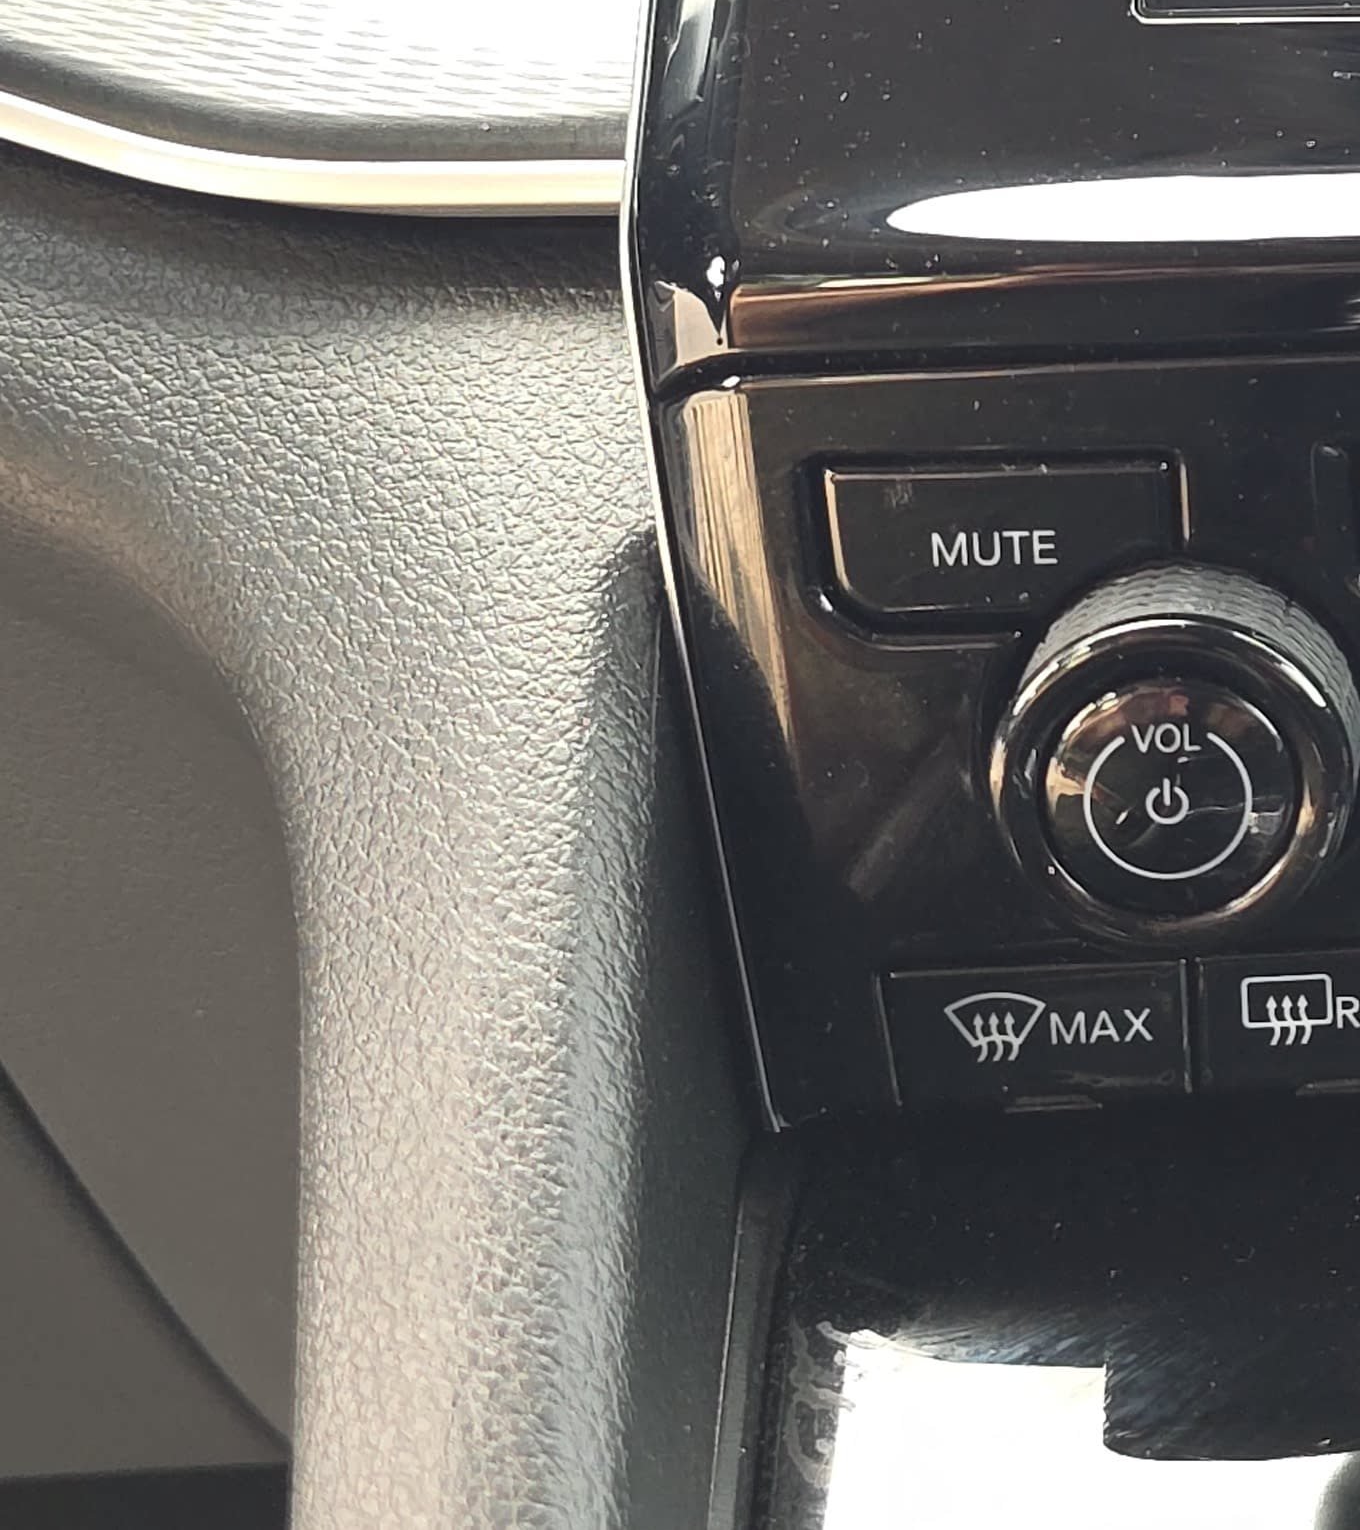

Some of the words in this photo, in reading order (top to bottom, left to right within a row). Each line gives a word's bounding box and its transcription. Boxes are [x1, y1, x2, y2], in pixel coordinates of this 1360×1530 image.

[931, 529, 1059, 568] MUTE
[1131, 723, 1202, 754] VOL
[1050, 1007, 1154, 1046] MAX
